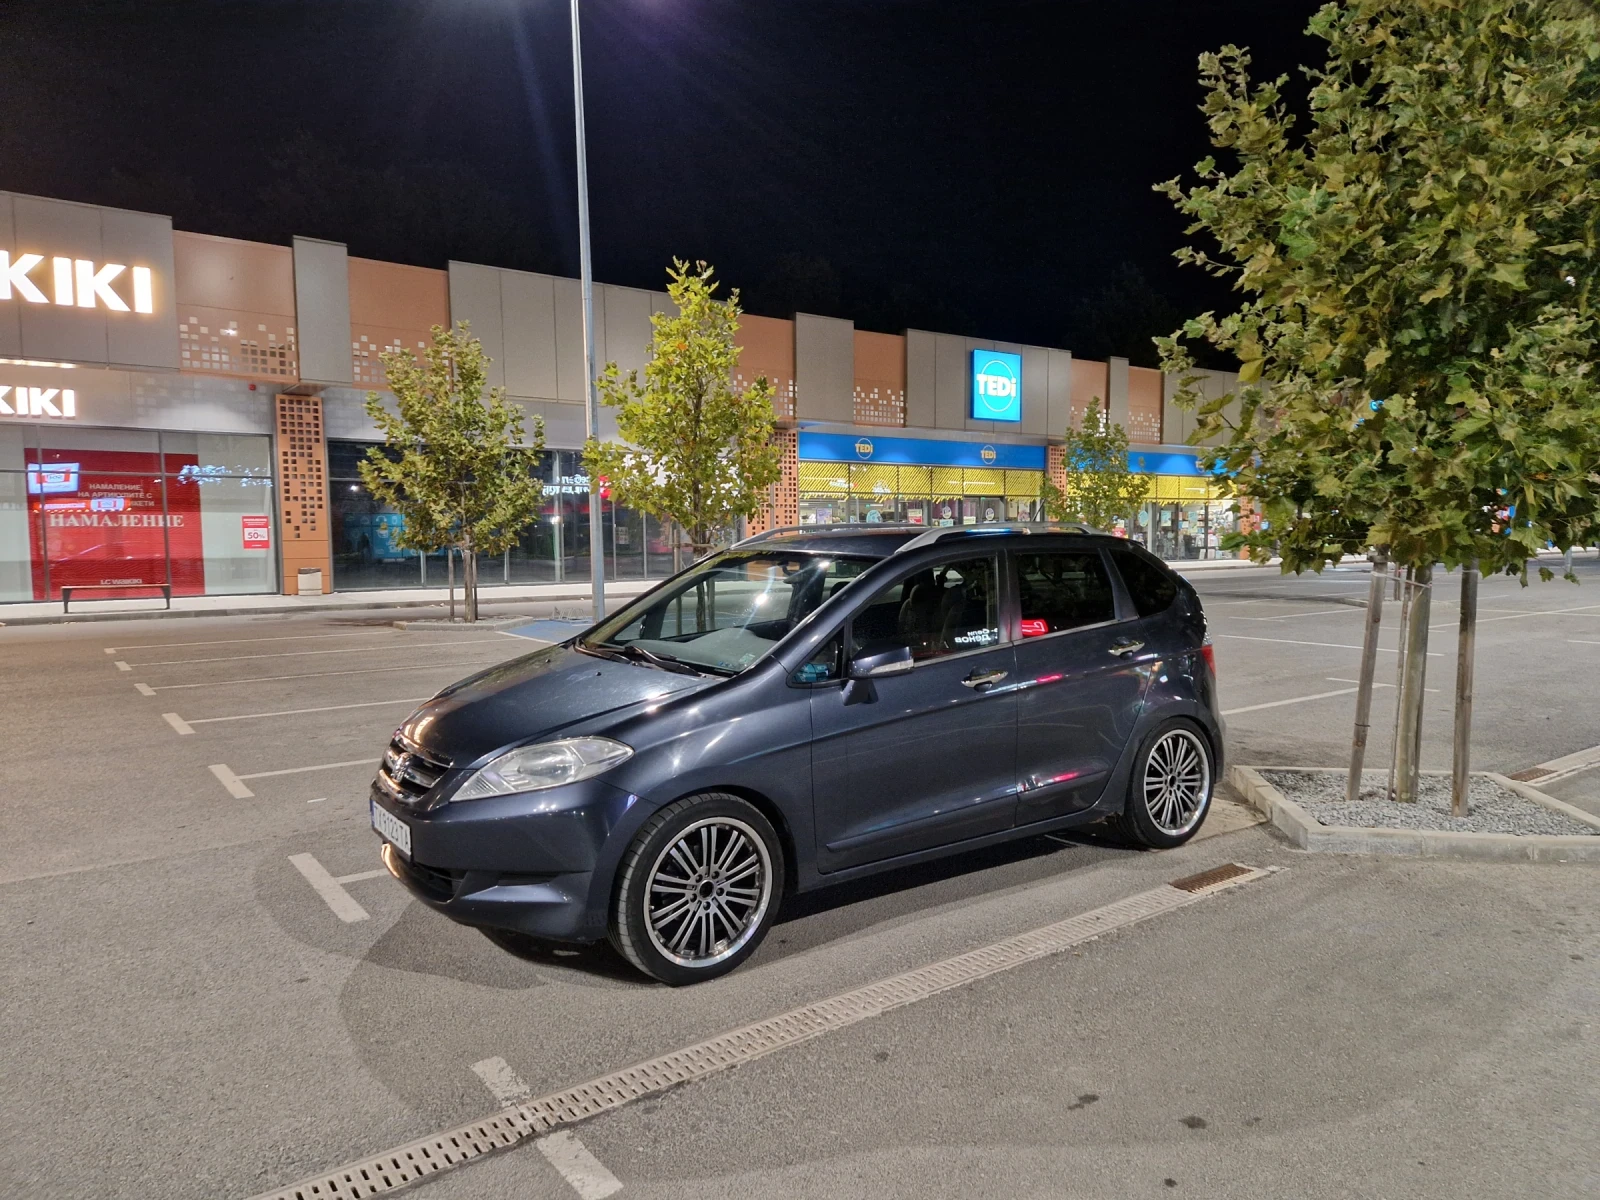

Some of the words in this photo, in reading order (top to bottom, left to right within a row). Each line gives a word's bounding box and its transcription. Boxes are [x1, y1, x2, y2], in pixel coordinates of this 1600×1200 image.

[0, 250, 153, 314] KIKI
[976, 373, 1017, 398] TEDi
[855, 443, 873, 453] TEDi
[981, 450, 996, 459] TEDi
[89, 483, 141, 491] НАМАЛЕНИЕ
[49, 513, 184, 528] НАМАЛЕНИЕ
